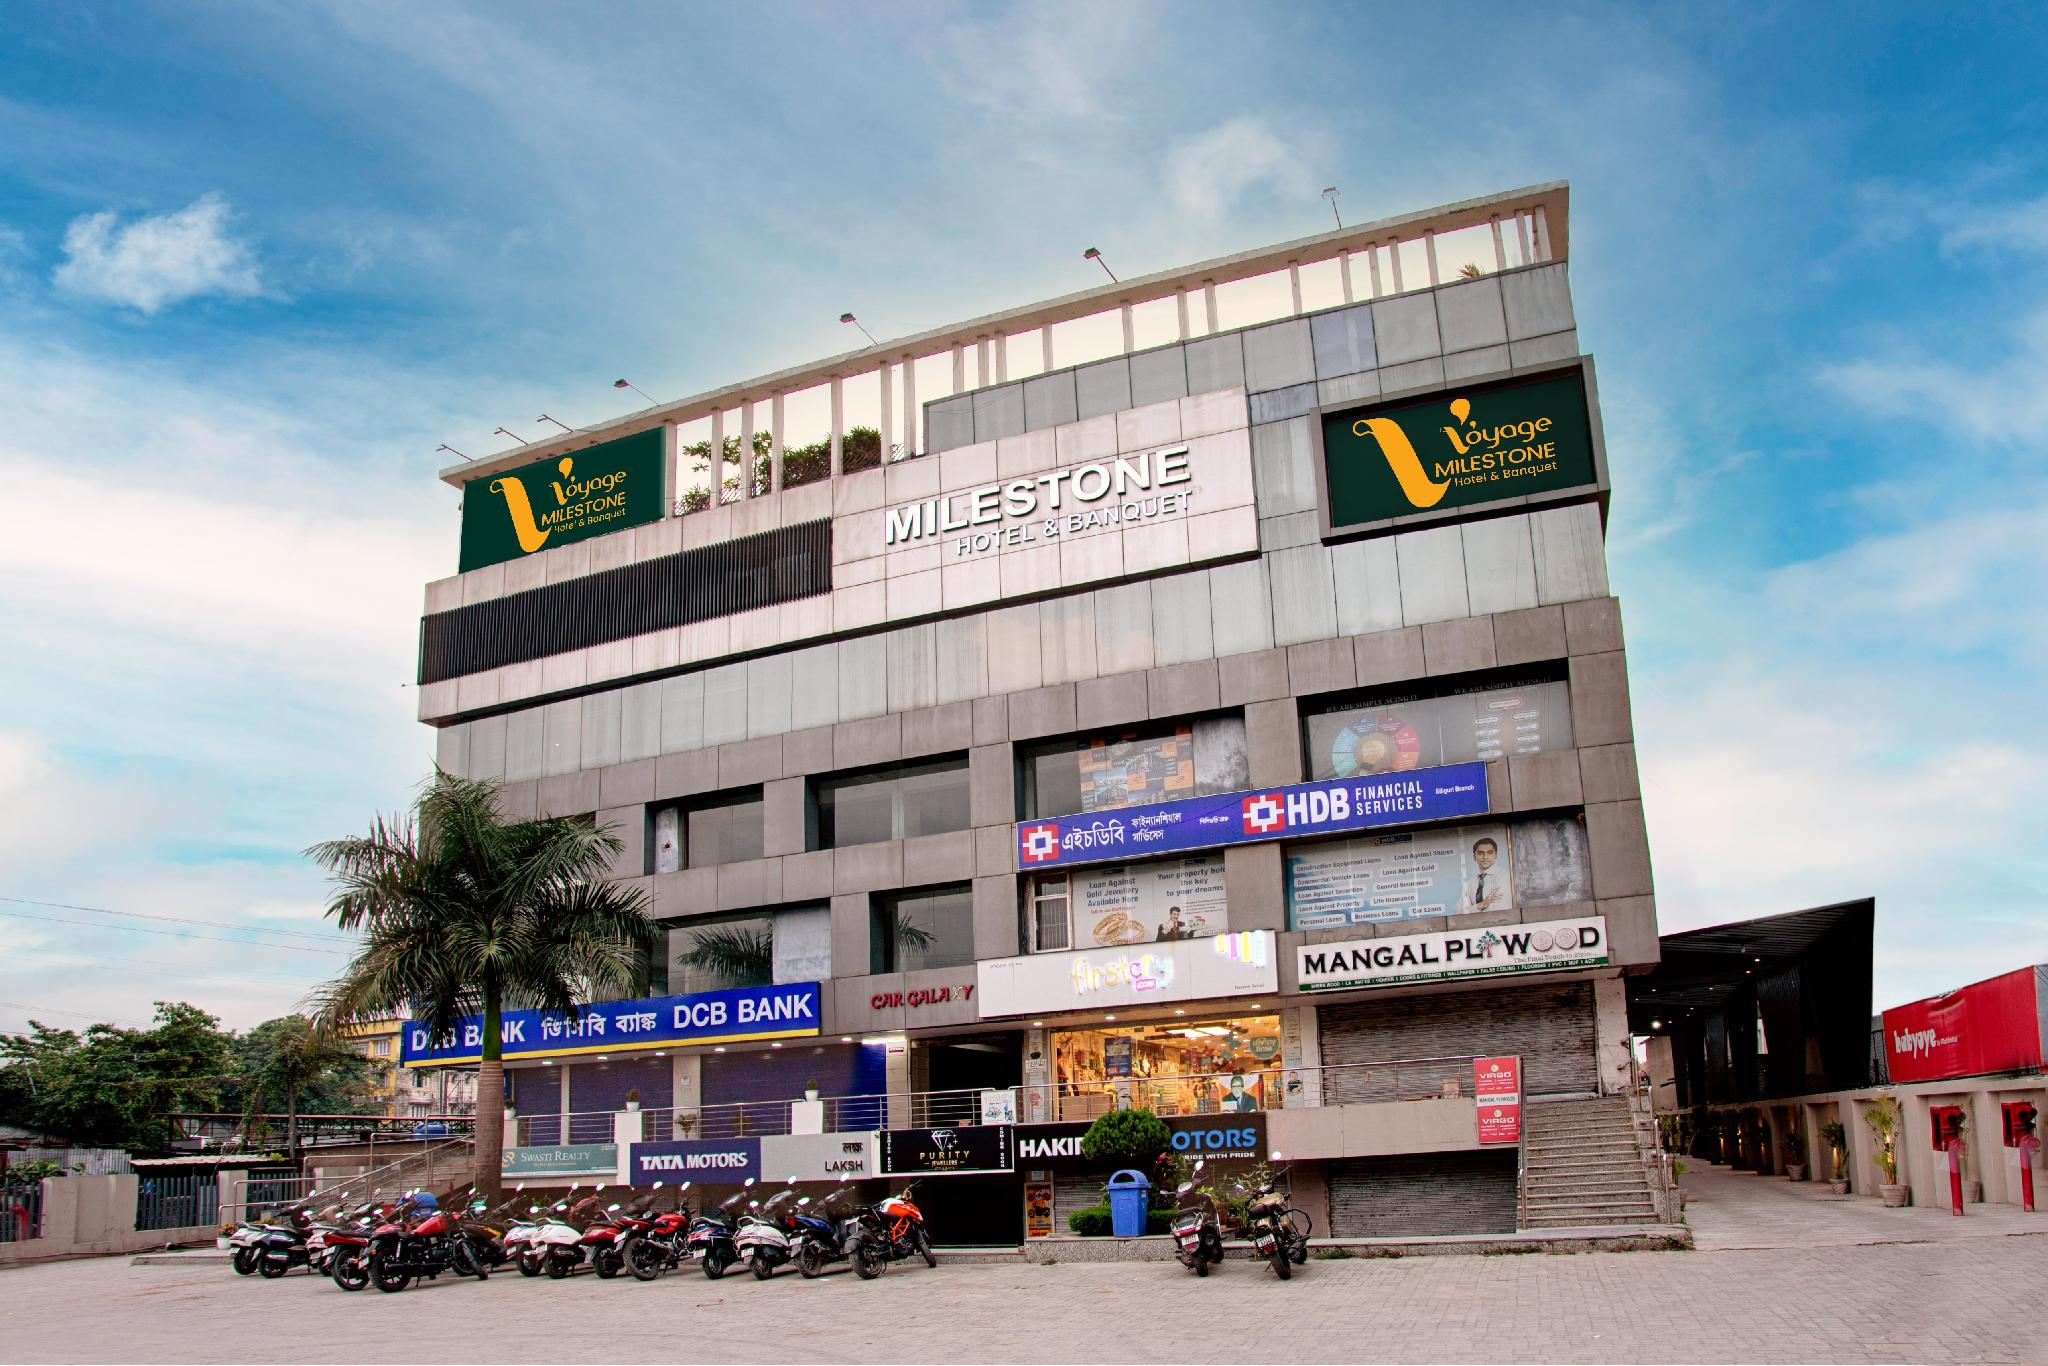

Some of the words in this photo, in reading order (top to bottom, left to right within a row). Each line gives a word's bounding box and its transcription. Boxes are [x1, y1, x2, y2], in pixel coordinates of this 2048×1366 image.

[1439, 415, 1553, 455] Voyage
[1435, 441, 1556, 478] MILESTONE
[1454, 472, 1487, 487] Hotel
[1490, 471, 1500, 481] &
[1502, 460, 1558, 479] Banquet
[548, 471, 627, 506] Voyage
[885, 445, 1191, 545] MILESTONE
[541, 491, 627, 527] MILESTONE
[578, 518, 585, 527] &
[587, 507, 626, 525] Banquet
[955, 526, 1036, 555] HOTEL
[1042, 518, 1060, 537] &
[1067, 490, 1194, 533] BANQUET
[1287, 788, 1350, 826] HDB
[1355, 781, 1423, 801] FINANCIAL
[1356, 796, 1423, 816] SERVICES
[1061, 818, 1125, 850] এইচডিবি
[1304, 945, 1439, 974] MANGAL
[1444, 926, 1600, 961] PLYWOOD
[871, 992, 903, 1009] CAR
[907, 985, 974, 1007] GALAXY
[673, 1002, 727, 1029] DCB
[737, 993, 813, 1024] BANK
[411, 1027, 457, 1052] DB
[1480, 1071, 1512, 1079] VIRGO
[1482, 1117, 1515, 1125] VIRGO
[1171, 1127, 1257, 1151] OTORS
[520, 1153, 552, 1162] SWASTI
[554, 1150, 591, 1161] REALTY
[640, 1155, 686, 1171] TATA
[686, 1152, 749, 1170] MOTORS
[825, 1160, 863, 1173] LAKSH
[919, 1150, 970, 1160] PURITY
[1229, 1151, 1255, 1159] PRIDE
